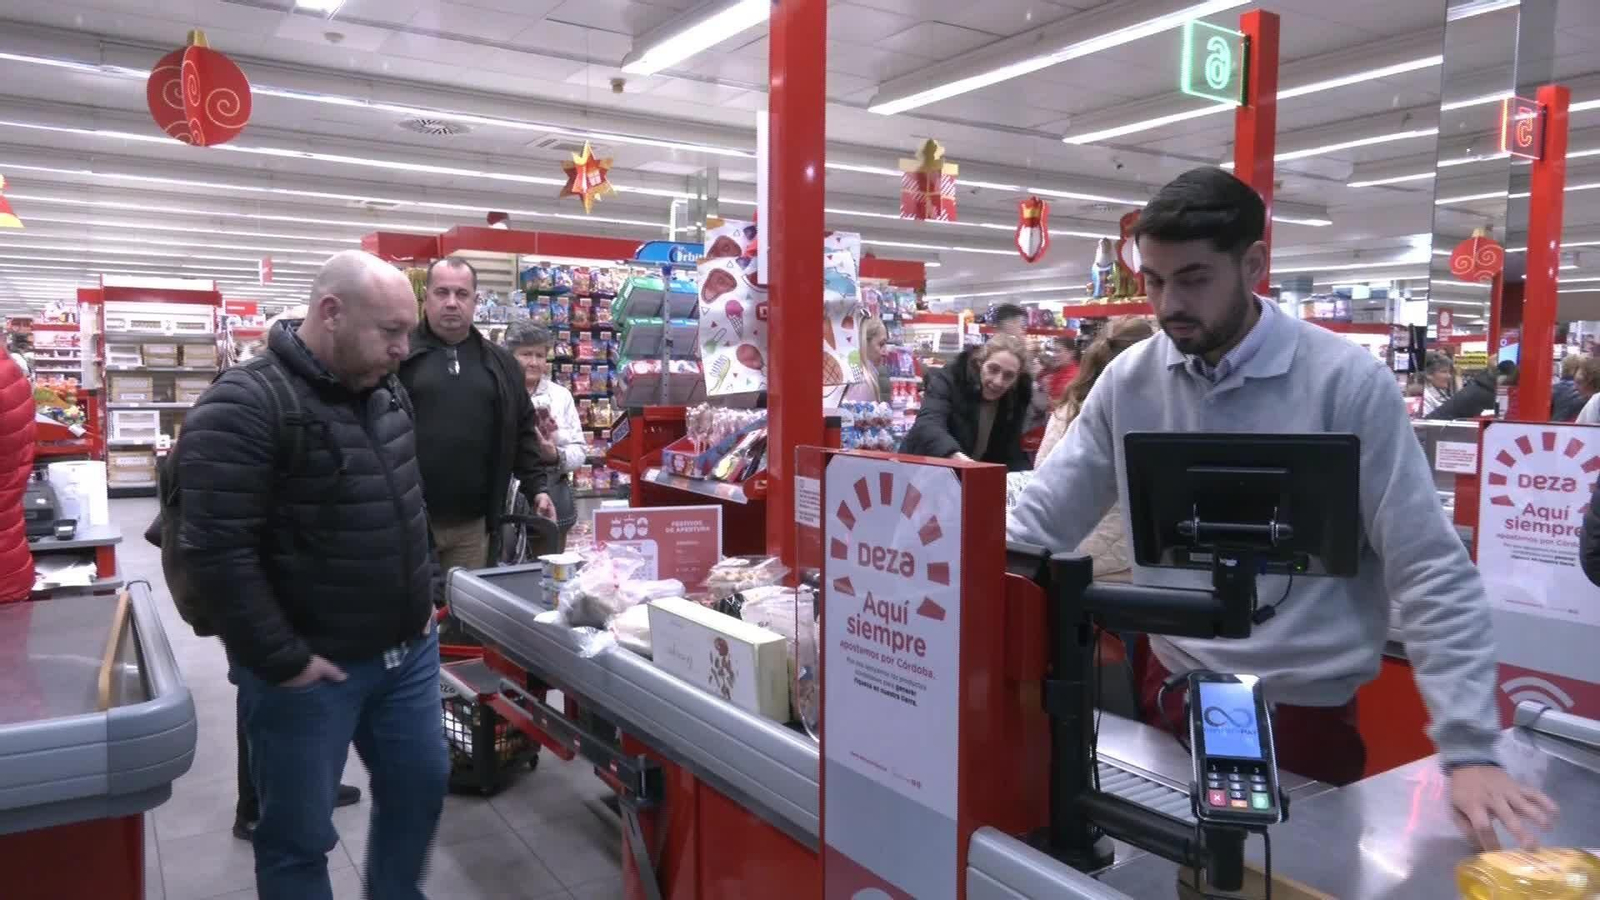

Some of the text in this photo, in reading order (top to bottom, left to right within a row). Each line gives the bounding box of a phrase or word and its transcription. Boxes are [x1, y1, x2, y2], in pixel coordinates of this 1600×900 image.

[1518, 474, 1577, 493] Deza
[1522, 503, 1570, 521] Aquí
[1505, 516, 1582, 538] siempre
[858, 542, 915, 578] Deza
[863, 591, 909, 625] Aquí
[846, 613, 926, 657] siempre
[840, 640, 879, 660] apostamos
[881, 654, 895, 666] por
